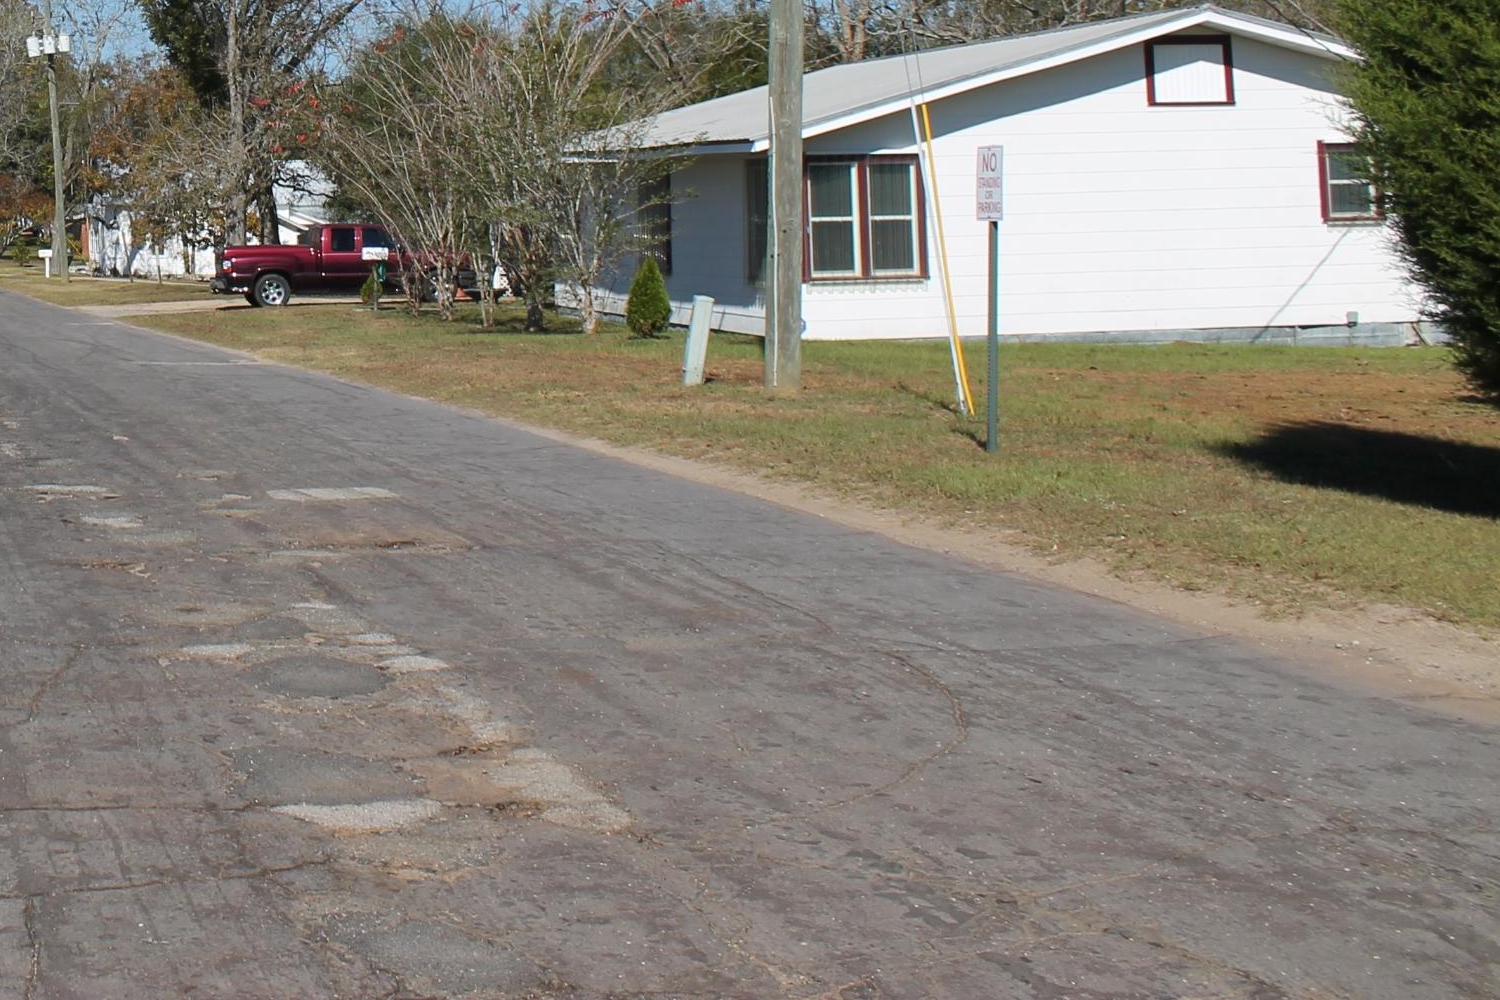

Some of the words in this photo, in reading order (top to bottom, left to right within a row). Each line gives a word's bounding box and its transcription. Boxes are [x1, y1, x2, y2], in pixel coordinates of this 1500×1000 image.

[982, 153, 997, 172] NO
[978, 177, 1001, 189] STANDING
[984, 191, 994, 200] OR
[978, 201, 1001, 213] PARKING
